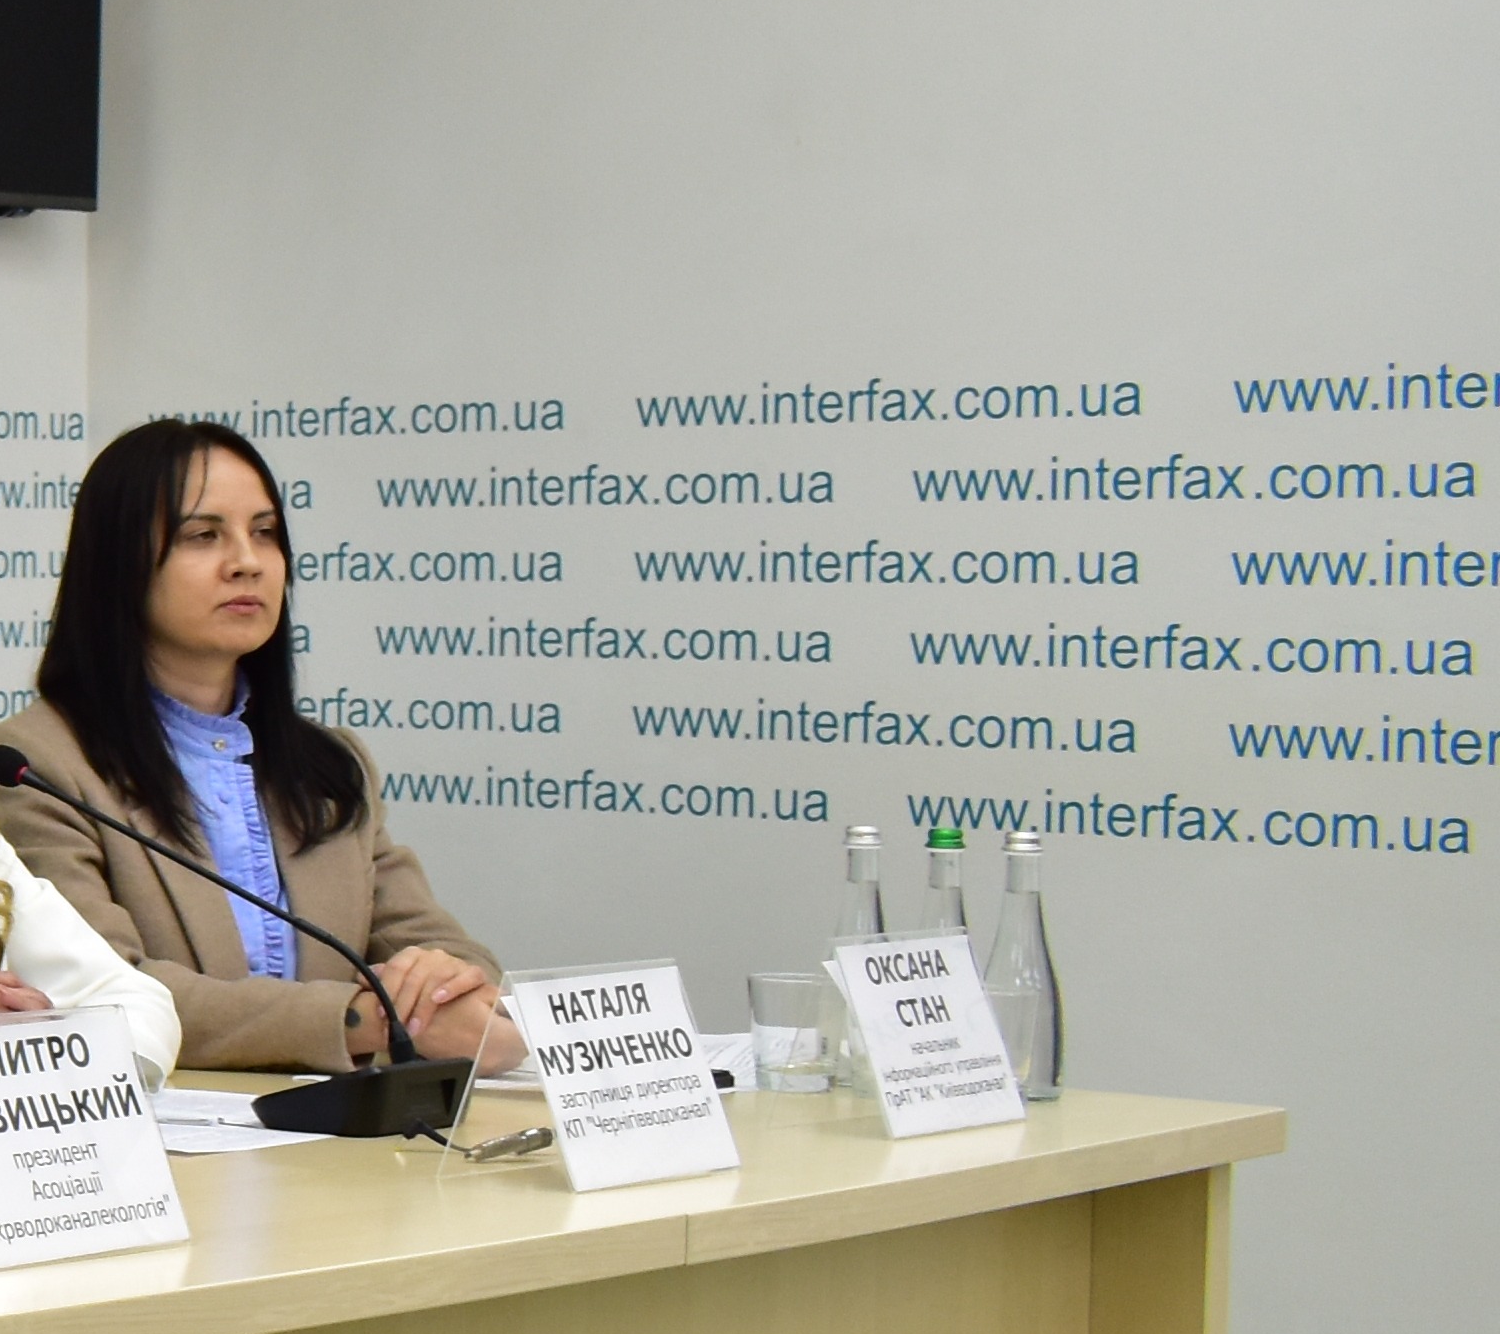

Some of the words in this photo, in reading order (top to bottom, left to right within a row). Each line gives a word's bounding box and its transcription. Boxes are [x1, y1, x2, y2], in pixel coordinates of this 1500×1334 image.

[148, 399, 566, 438] w.interfax.com.ua
[637, 378, 1141, 427] www.interfax.com.ua
[379, 464, 834, 507] www.interfax.com.ua
[912, 454, 1474, 502] www.interfax.com.ua
[635, 539, 1138, 585] www.interfax.com.ua
[378, 617, 832, 663] www.interfax.com.ua
[910, 623, 1471, 676] www.interfax.com.ua
[633, 700, 1135, 753] www.interfax.com.ua
[906, 787, 1468, 858] www.interfax.com.ua
[865, 949, 950, 985] ОКСАНА
[548, 982, 651, 1025] НАТАЛЯ
[895, 995, 951, 1027] СТАН
[537, 1027, 693, 1077] МУЗИЧЕНКО
[636, 1073, 702, 1099] директора
[563, 1118, 586, 1139] КП
[12, 1142, 98, 1173] президент
[32, 1171, 104, 1201] Асоціації
